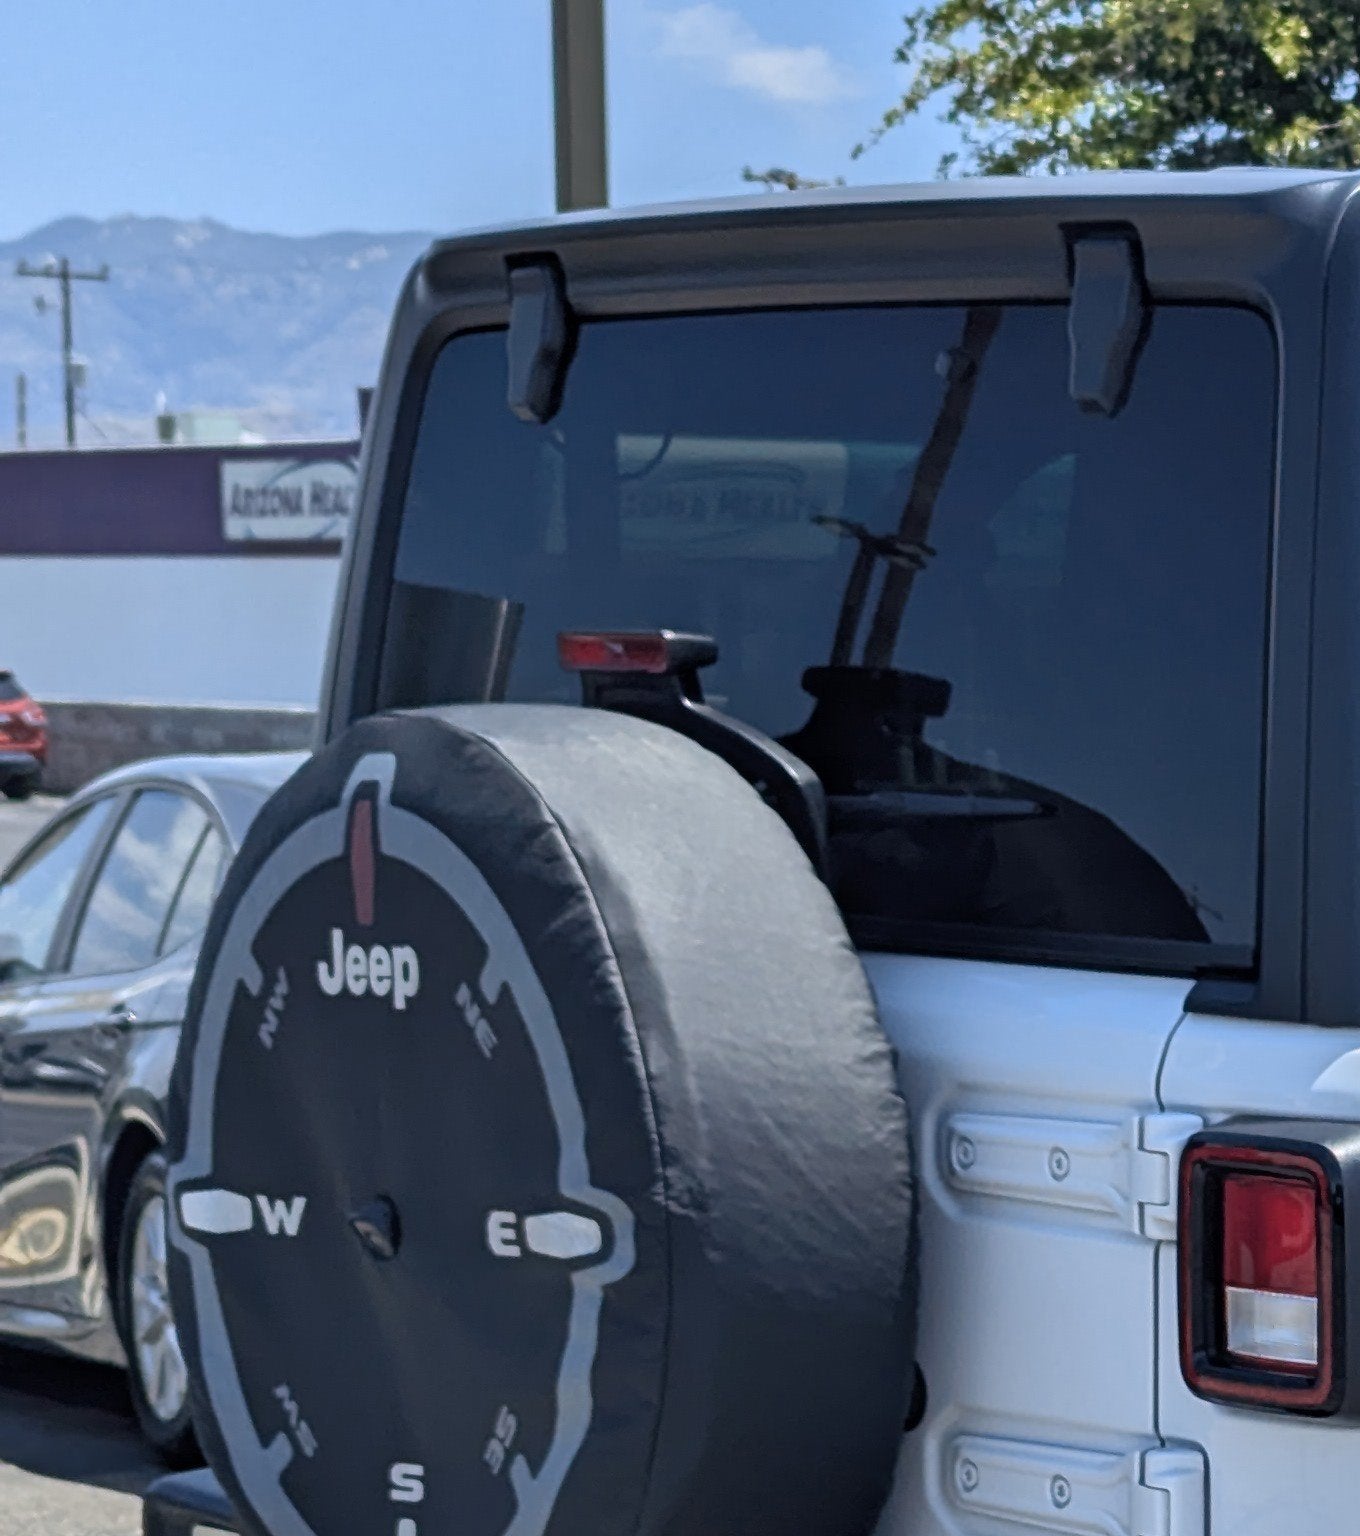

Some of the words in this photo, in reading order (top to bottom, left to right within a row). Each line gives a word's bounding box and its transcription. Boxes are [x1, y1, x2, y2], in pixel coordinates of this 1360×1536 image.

[316, 927, 420, 1011] Jeep
[455, 981, 499, 1059] NE
[255, 1193, 307, 1237] W
[485, 1209, 522, 1258] E
[390, 1462, 425, 1503] S
